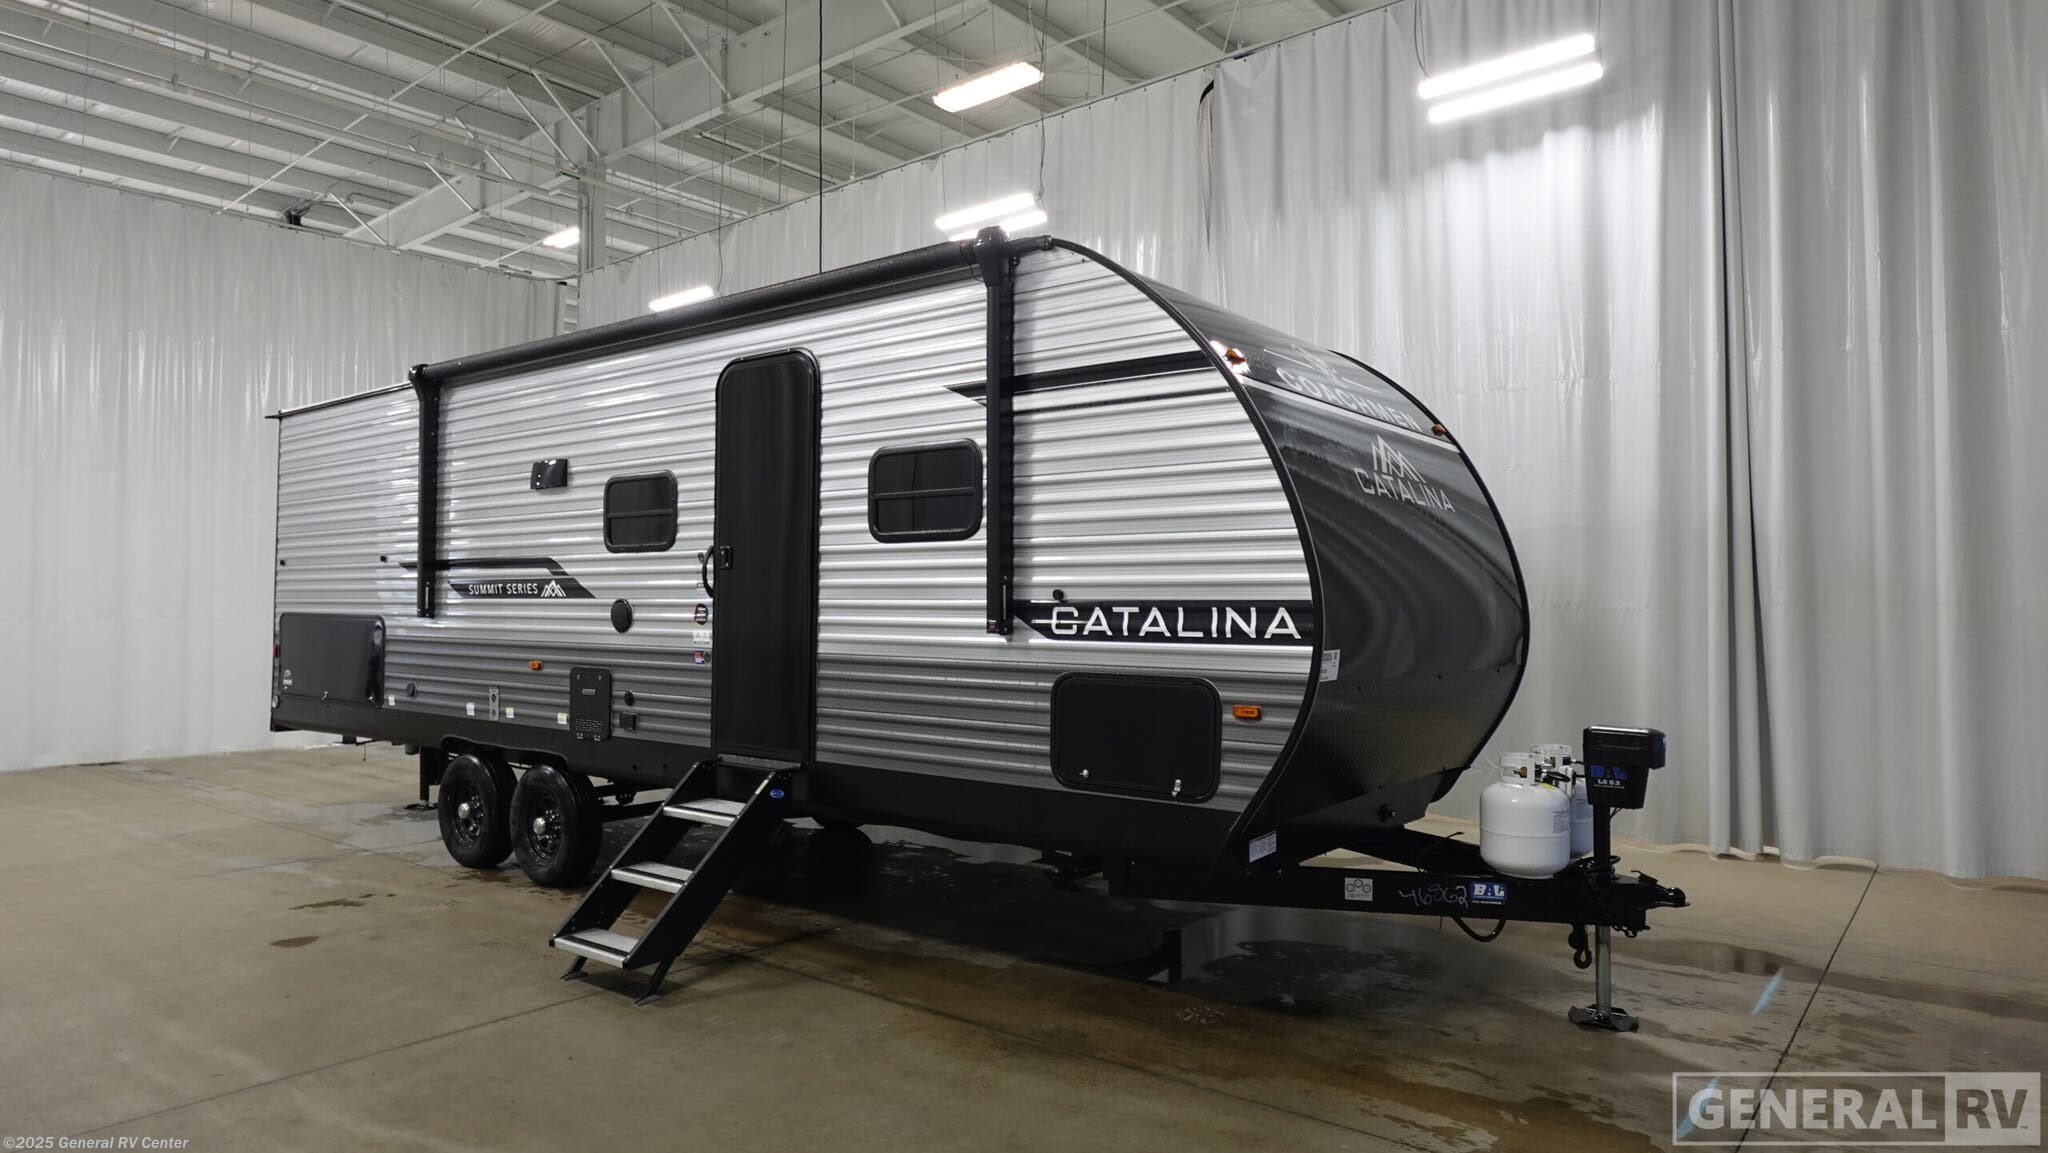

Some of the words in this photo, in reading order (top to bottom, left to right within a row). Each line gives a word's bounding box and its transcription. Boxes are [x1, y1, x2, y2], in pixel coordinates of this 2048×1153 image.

[1276, 367, 1423, 432] COACHMEN
[1354, 467, 1456, 513] CATALINA
[468, 583, 503, 596] SUMMIT
[507, 583, 539, 595] SERIES
[1051, 606, 1302, 640] CATALINA
